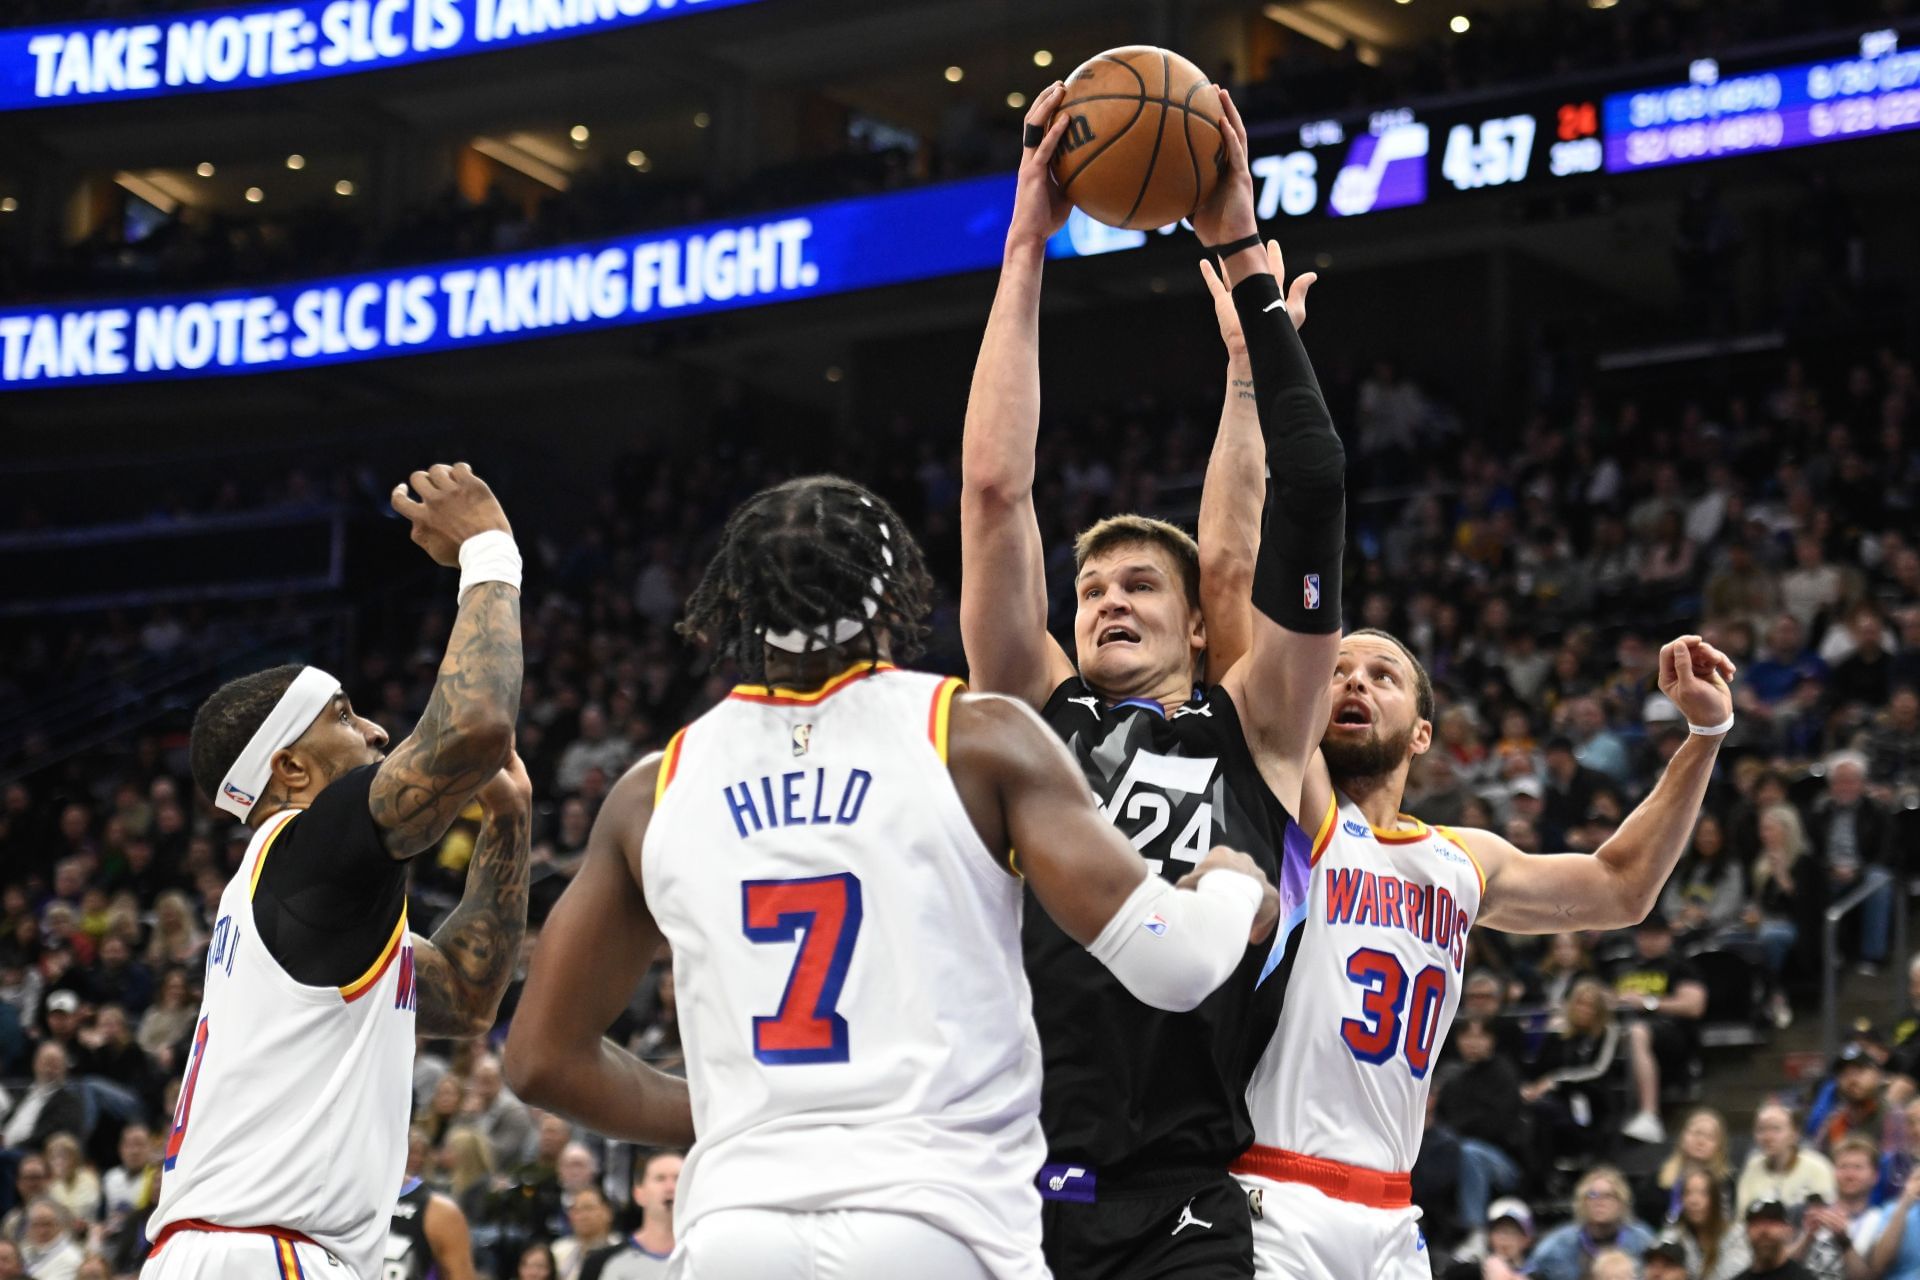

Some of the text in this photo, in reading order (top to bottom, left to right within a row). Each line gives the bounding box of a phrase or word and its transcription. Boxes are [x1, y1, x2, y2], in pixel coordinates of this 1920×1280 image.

[28, 25, 161, 97] TAKE
[165, 10, 317, 86] NOTE:
[319, 0, 409, 67] SLC
[412, 0, 464, 51] IS
[1251, 152, 1317, 220] 76
[0, 218, 819, 381] TAKE NOTE: SLC IS TAKING FLIGHT.
[723, 767, 873, 838] HIELD
[1126, 791, 1213, 876] 24
[741, 871, 863, 1066] 7
[1340, 946, 1447, 1080] 30
